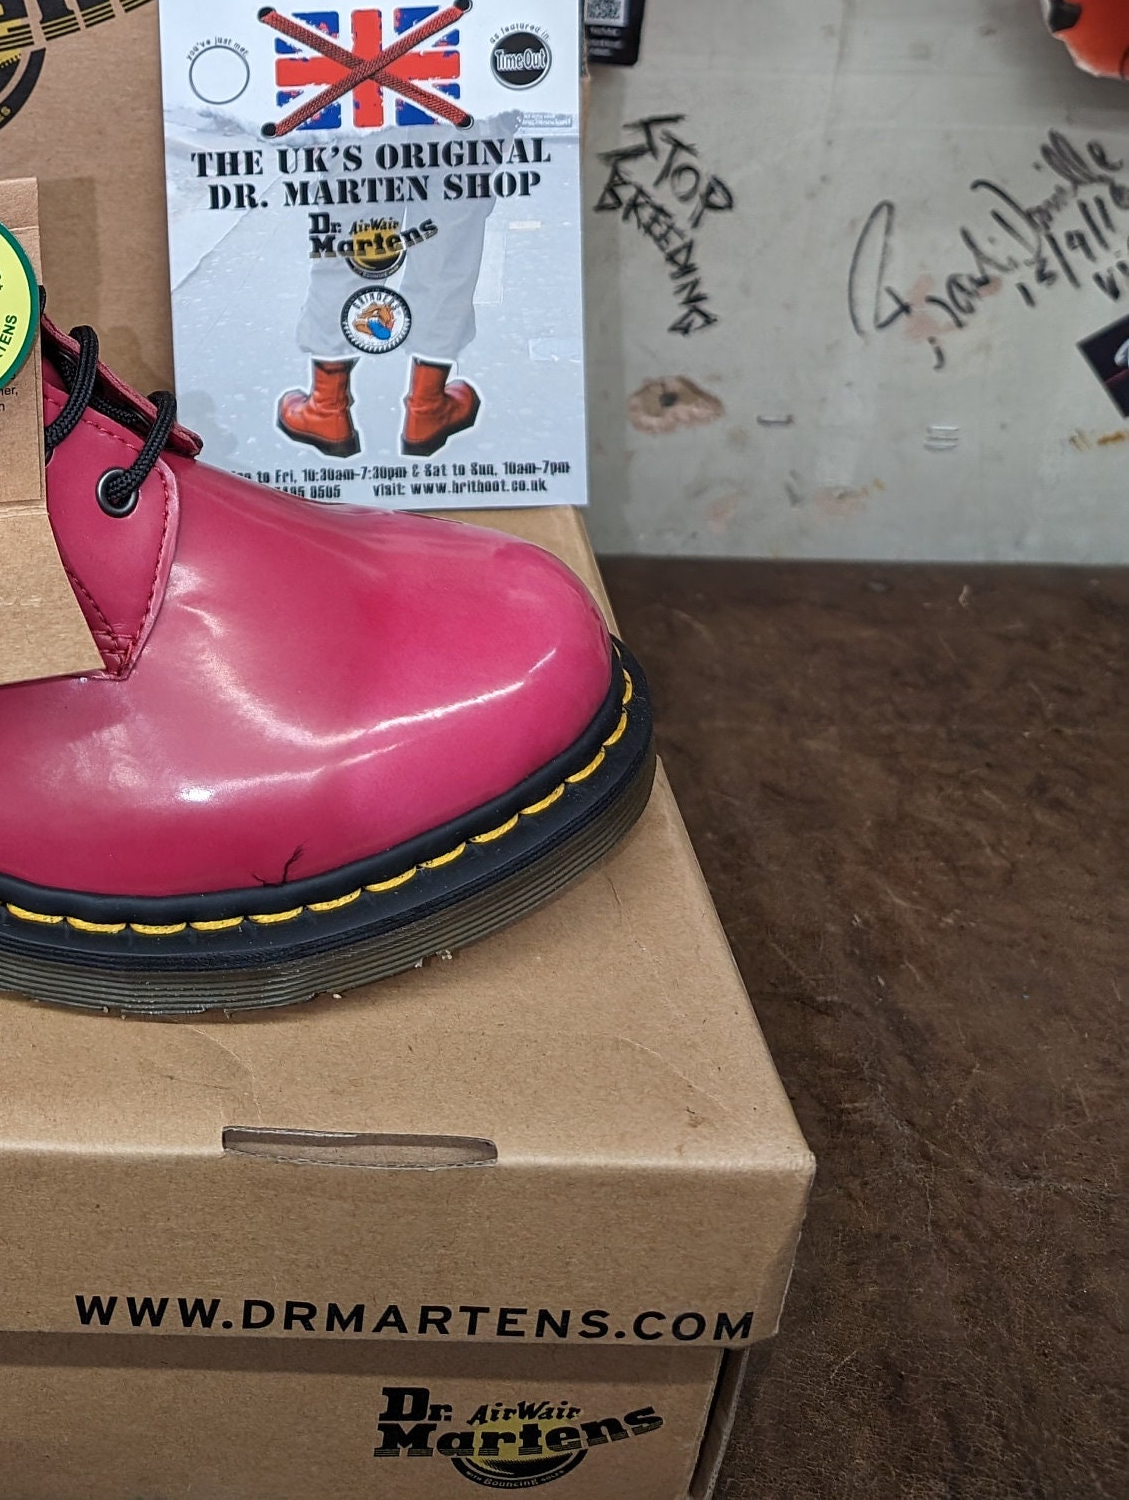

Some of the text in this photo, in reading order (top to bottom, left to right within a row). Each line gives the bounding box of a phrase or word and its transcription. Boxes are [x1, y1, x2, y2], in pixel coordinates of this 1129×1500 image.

[191, 151, 263, 177] THE
[375, 137, 552, 170] ORIGINAL
[208, 171, 542, 211] DR. MARTEN SHOP
[308, 211, 400, 235] Dr. AirWair
[309, 218, 439, 259] Martens
[256, 470, 270, 484] to
[412, 465, 420, 477] &
[424, 464, 448, 477] Sat
[452, 463, 467, 477] to
[503, 460, 572, 476] 10am-7pm
[373, 482, 406, 497] visit:
[74, 1294, 756, 1342] WWW.DRMARTENS.COM
[379, 1386, 583, 1425] Dr. AirWair
[373, 1405, 666, 1457] Martens
